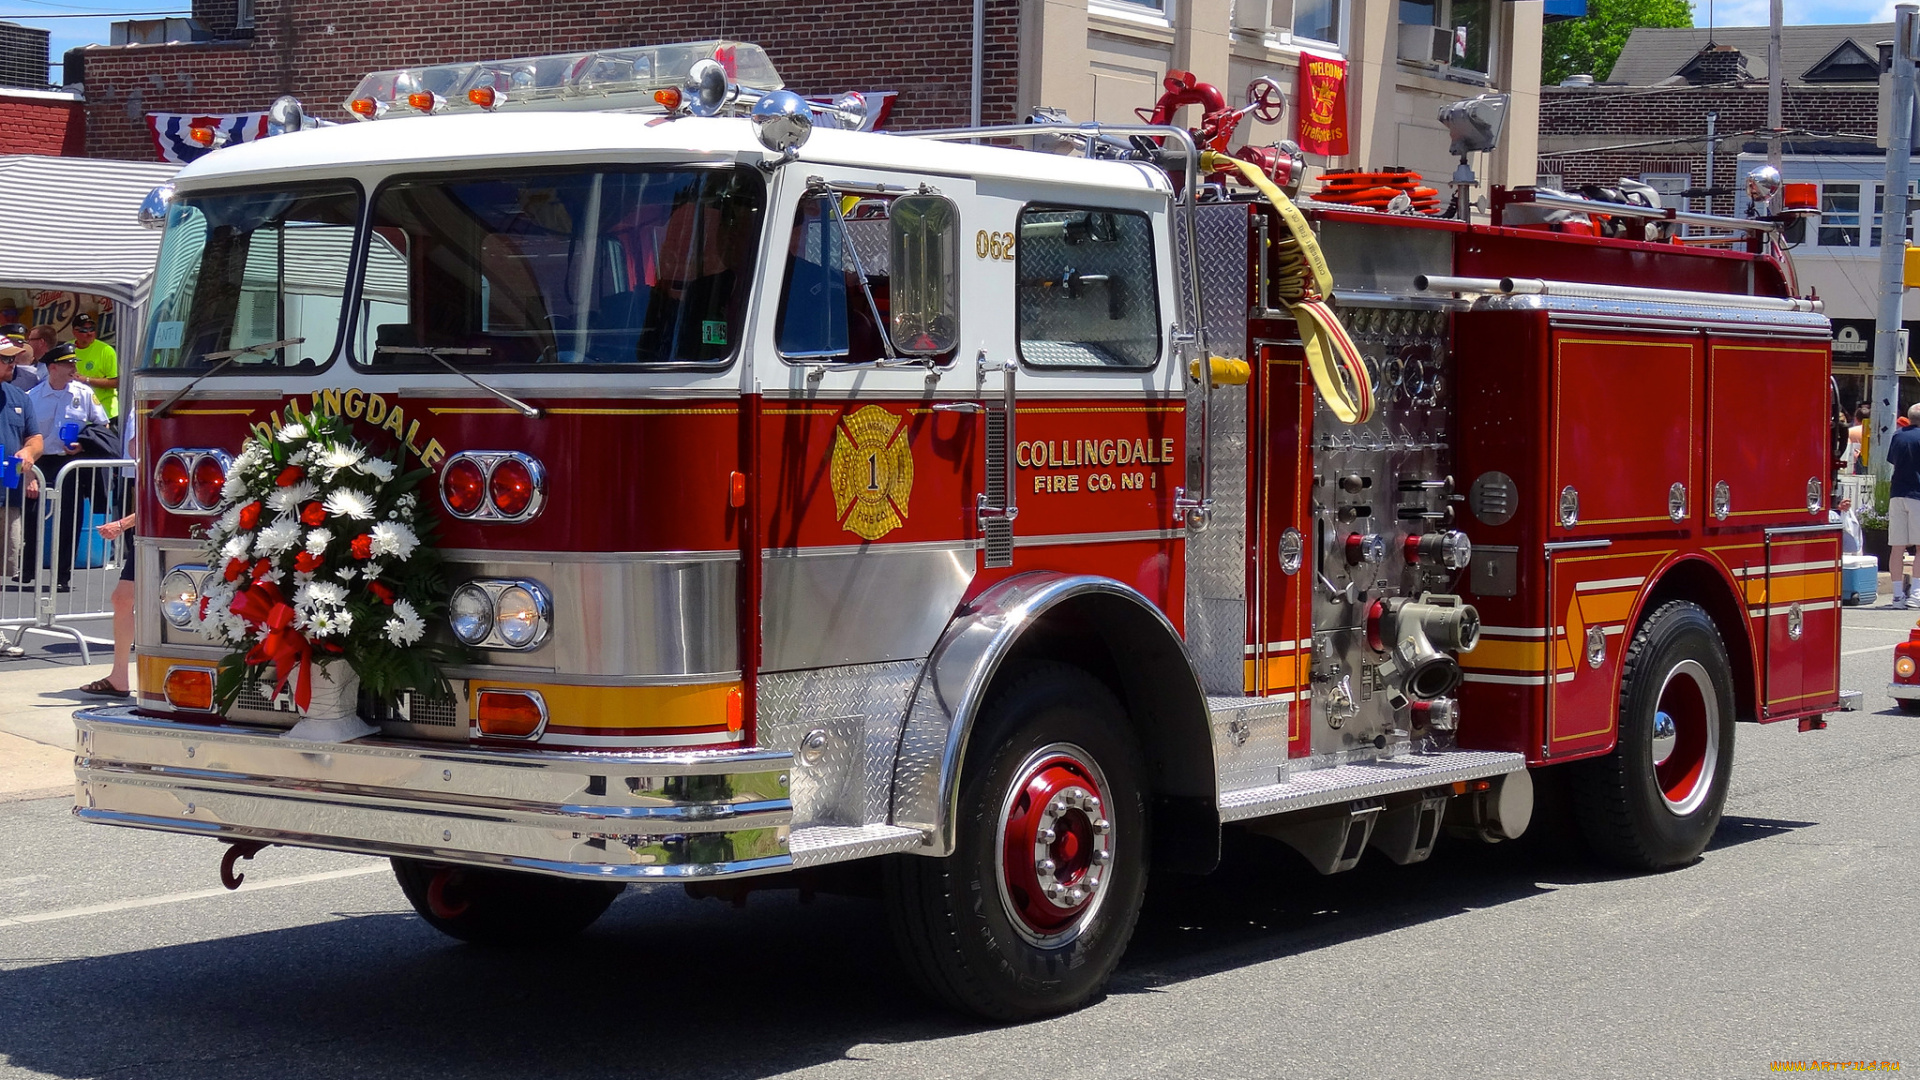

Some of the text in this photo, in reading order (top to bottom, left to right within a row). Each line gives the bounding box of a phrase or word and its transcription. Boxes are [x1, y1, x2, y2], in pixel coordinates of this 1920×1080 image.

[975, 229, 1015, 262] 062
[1016, 438, 1175, 467] COLLINGDALE
[867, 452, 879, 491] 1
[1034, 475, 1080, 494] FIRE
[1087, 473, 1116, 492] CO.
